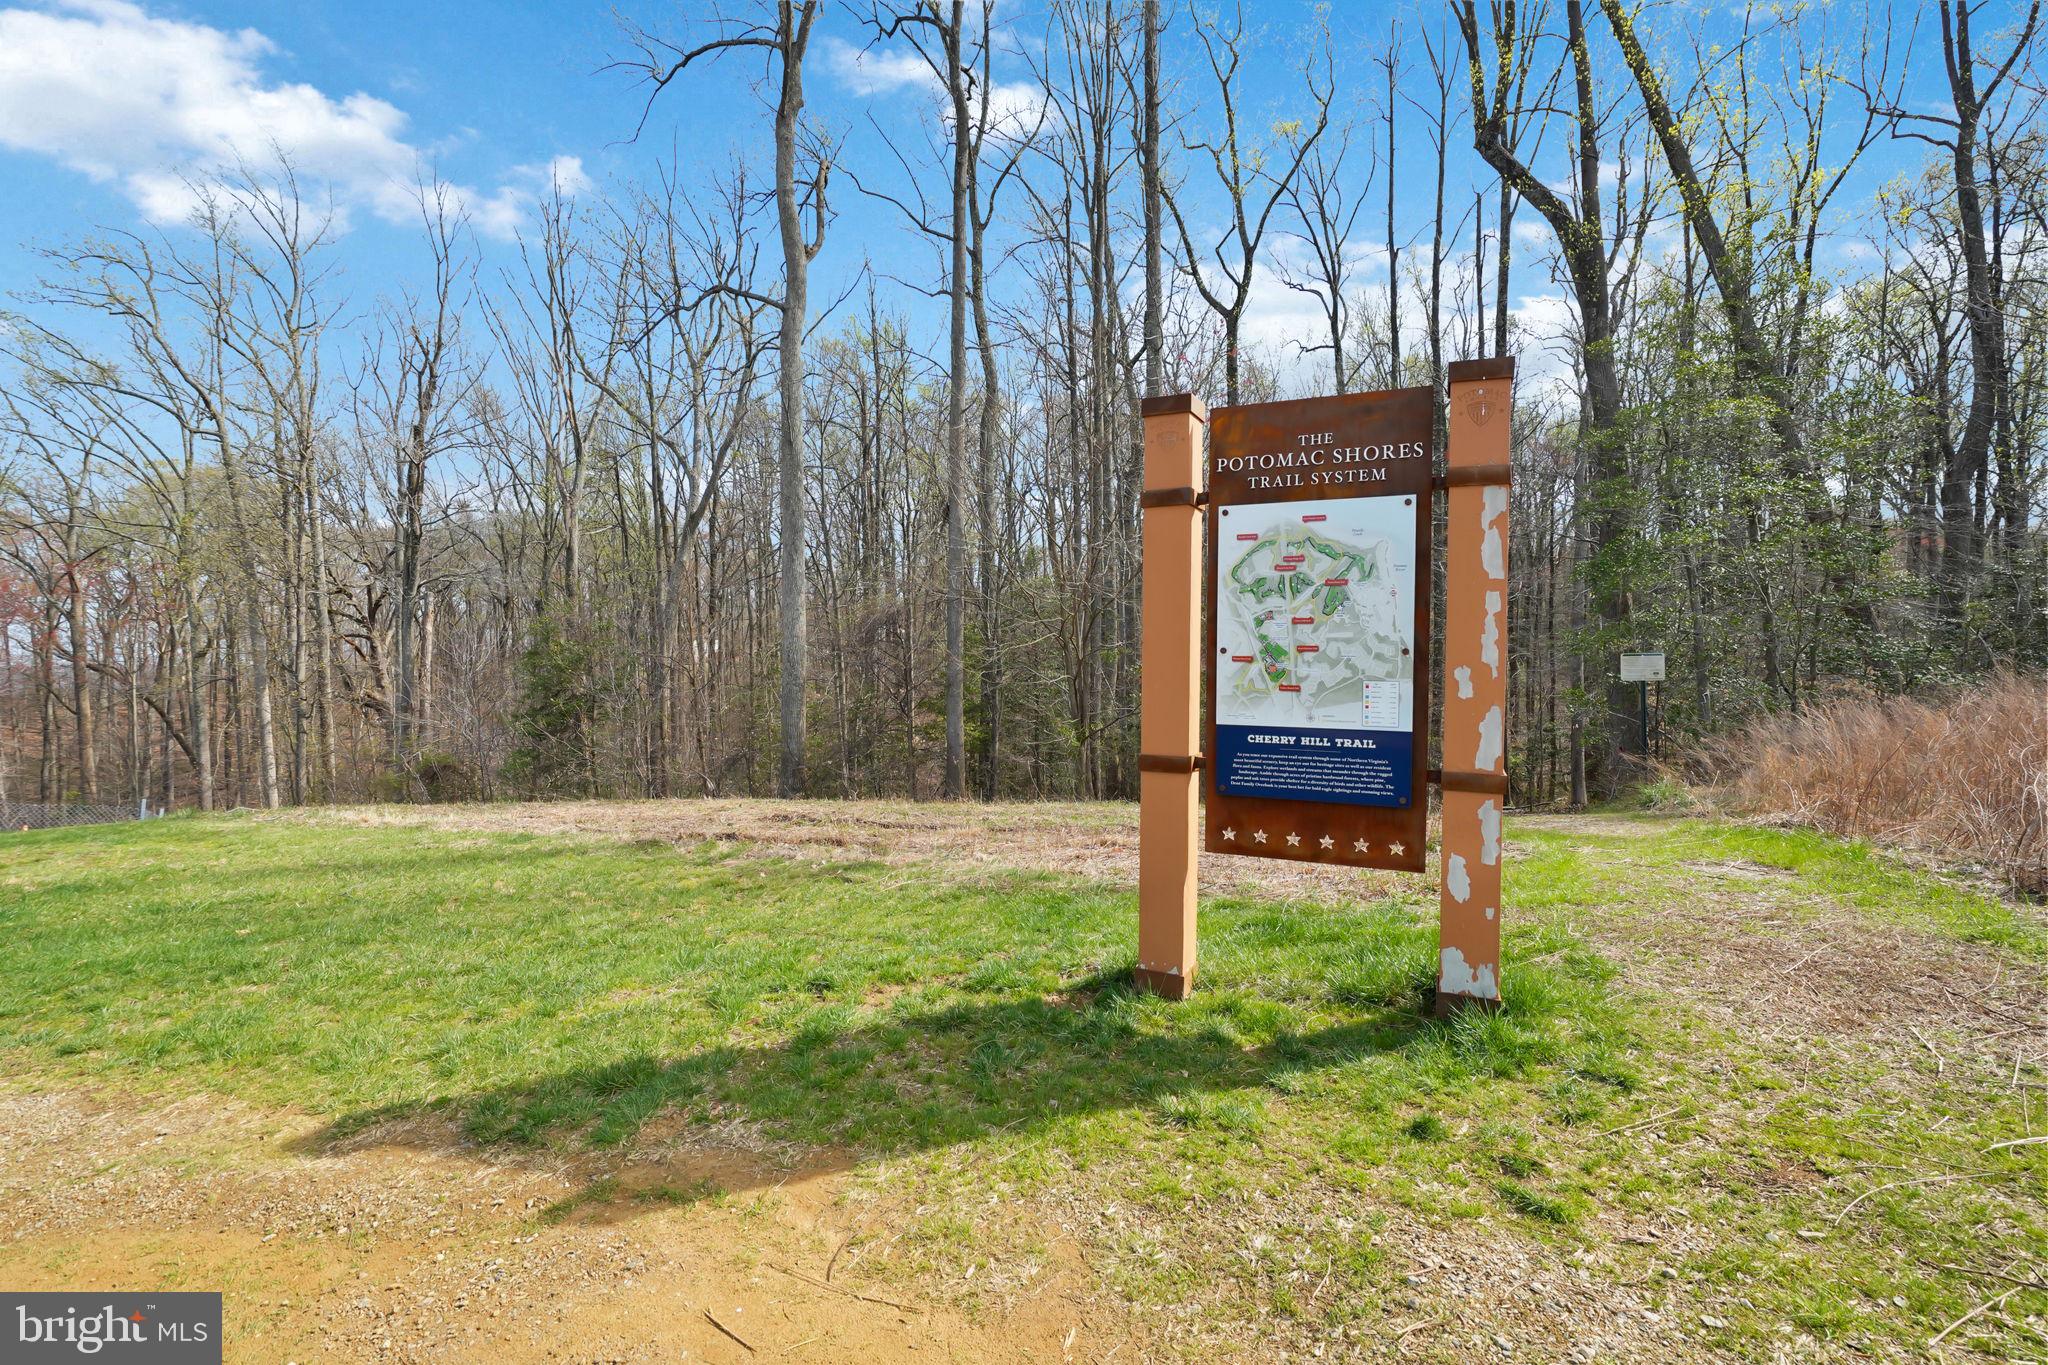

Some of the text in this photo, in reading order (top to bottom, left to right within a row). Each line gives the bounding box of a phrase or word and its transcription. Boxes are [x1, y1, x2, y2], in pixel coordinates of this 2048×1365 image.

[1298, 432, 1333, 446] THE
[1216, 442, 1424, 472] POTOMAC SHORES
[1248, 468, 1386, 489] TRAIL SYSTEM
[1248, 735, 1376, 748] CHERRY HILL TRAIL
